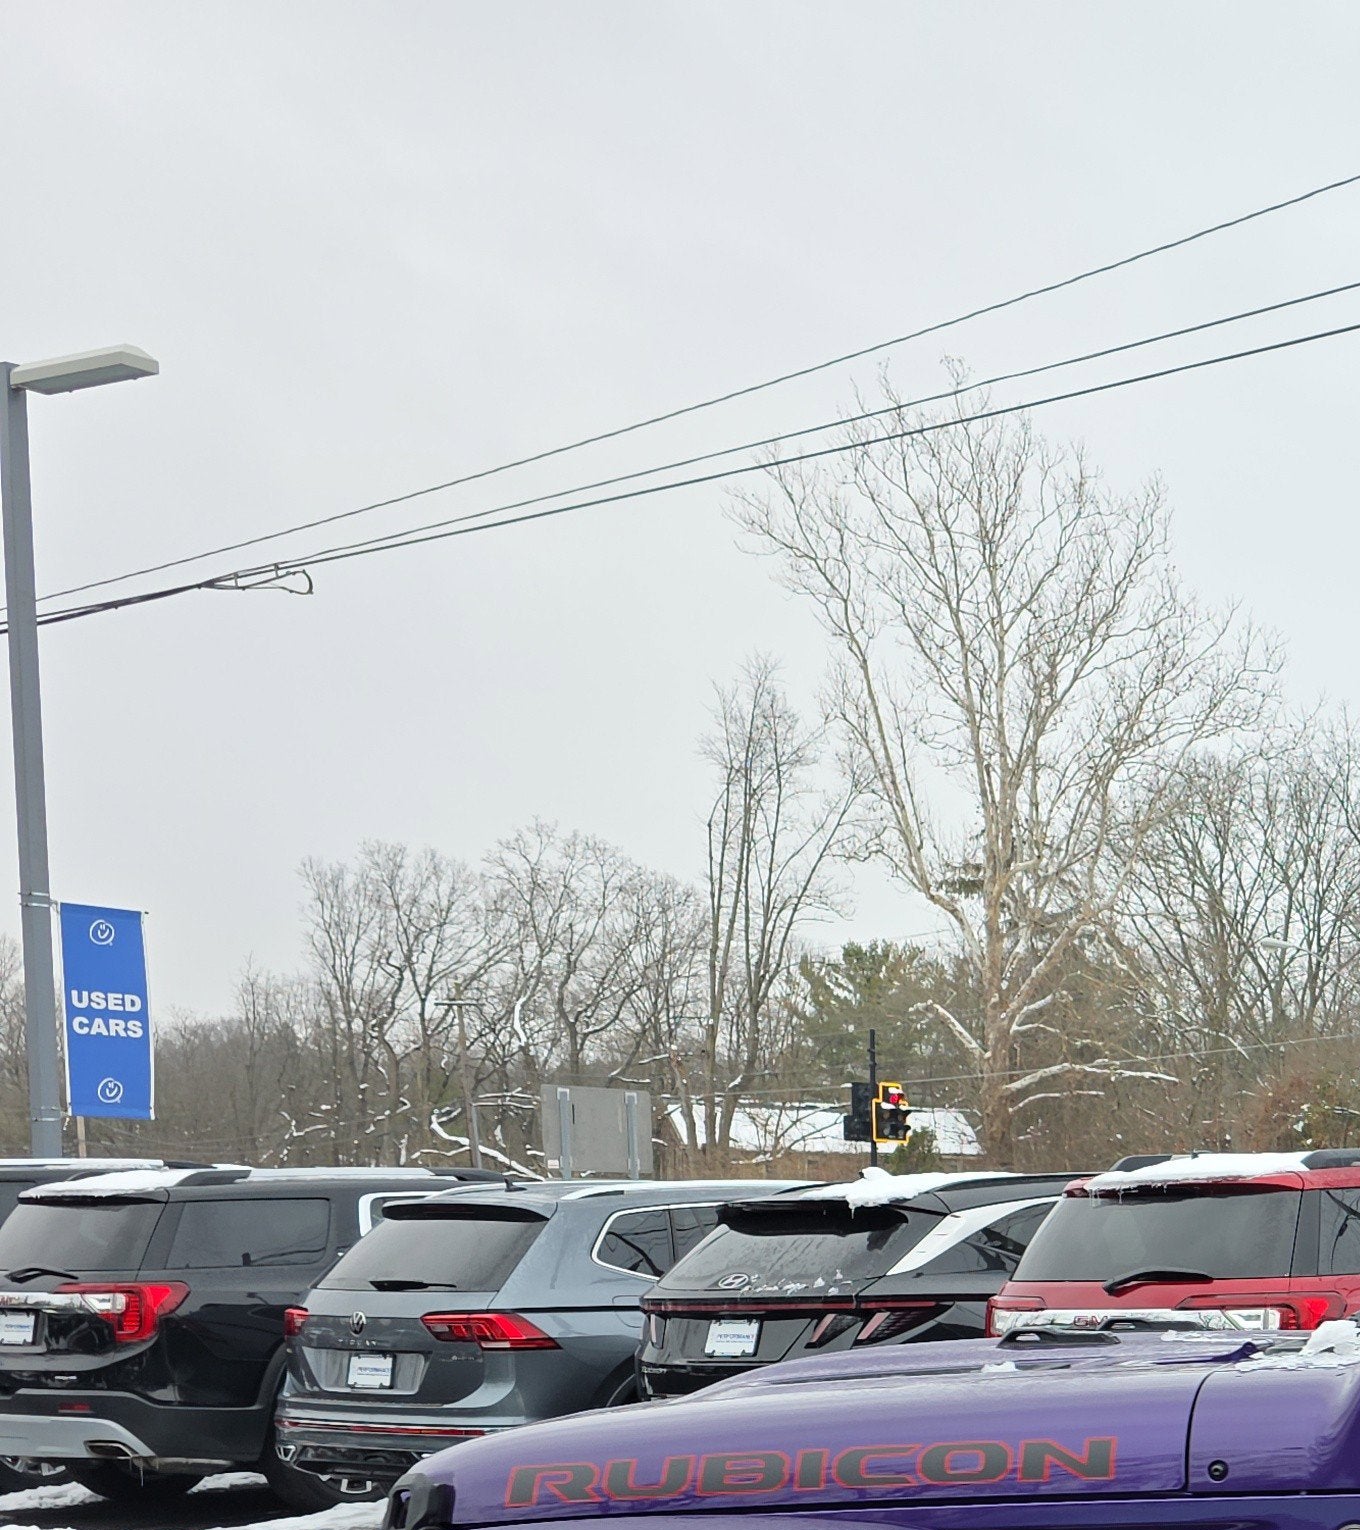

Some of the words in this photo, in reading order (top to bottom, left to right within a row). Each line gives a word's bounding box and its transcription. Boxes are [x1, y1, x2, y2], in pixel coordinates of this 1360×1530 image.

[71, 989, 142, 1012] USED
[72, 1016, 143, 1038] CARS
[1074, 1315, 1126, 1327] GM
[505, 1436, 1119, 1507] RUBICON
